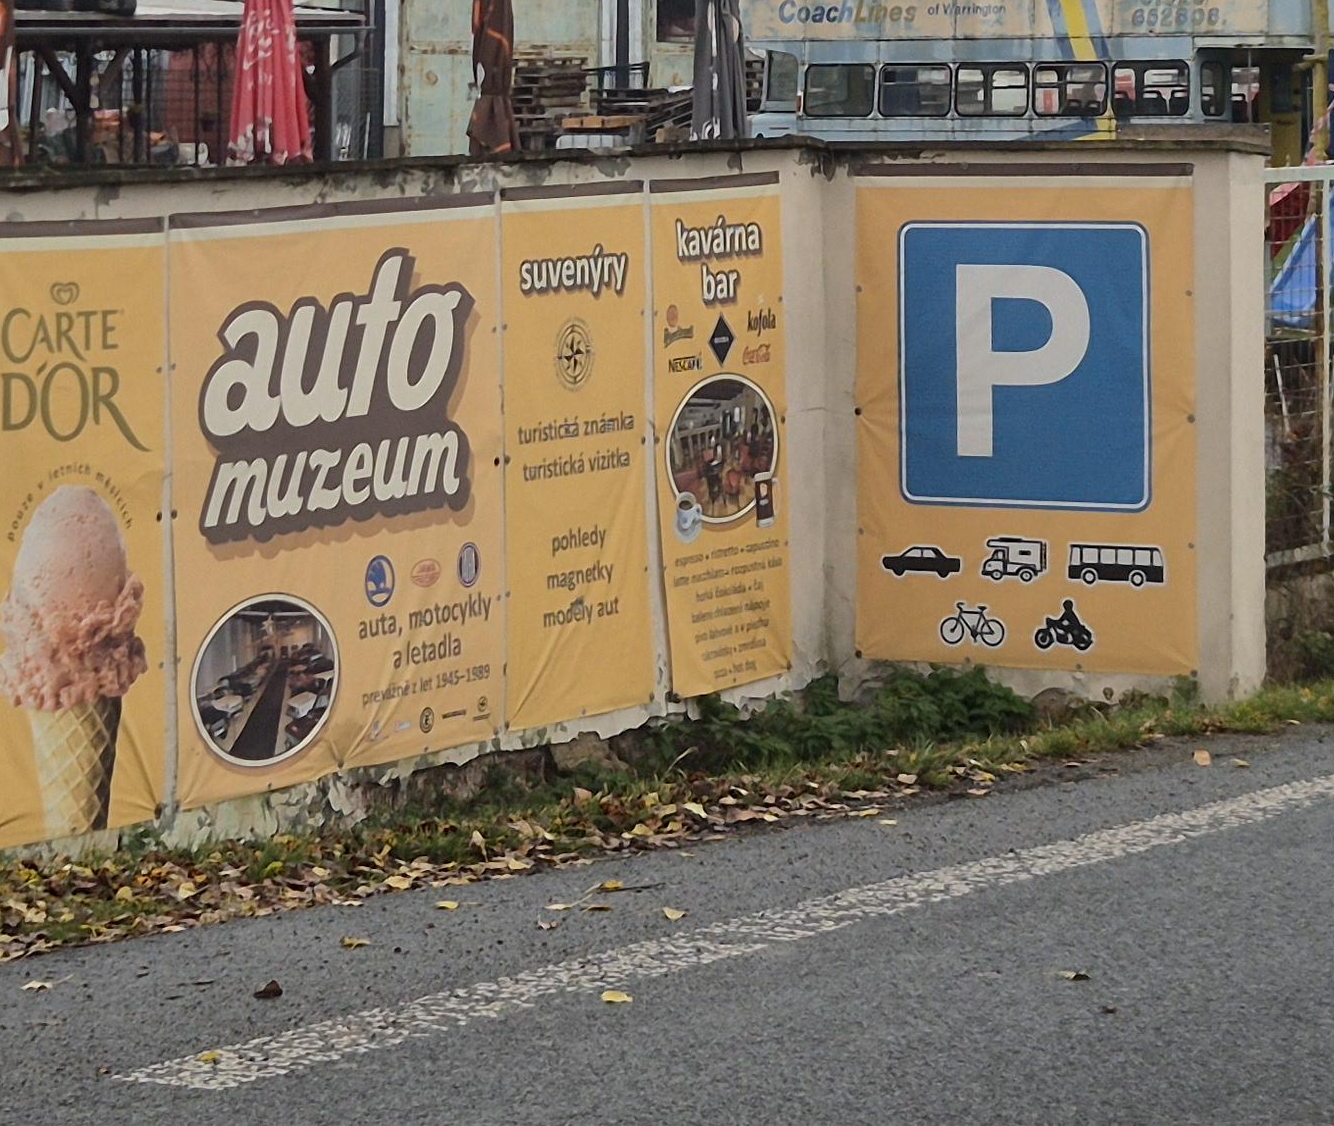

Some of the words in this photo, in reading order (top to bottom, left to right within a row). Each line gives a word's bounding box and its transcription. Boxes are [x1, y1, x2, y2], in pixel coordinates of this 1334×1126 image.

[927, 2, 939, 16] of
[942, 0, 1007, 19] Warrington
[675, 216, 763, 260] kavárna
[520, 243, 628, 295] suvenýry
[701, 264, 739, 302] bar
[0, 306, 120, 364] CARTE
[747, 308, 777, 337] kofola
[202, 252, 467, 440] auto
[956, 263, 1091, 457] P
[518, 415, 580, 445] turistická
[583, 410, 635, 437] známka
[202, 429, 464, 529] muzeum
[522, 454, 585, 482] turistická
[589, 447, 631, 472] vizitka
[551, 524, 607, 557] pohledy
[546, 560, 614, 592] magnetky
[358, 613, 403, 640] auta,
[408, 591, 492, 630] motocykly
[543, 599, 594, 629] modely
[597, 596, 620, 618] aut
[392, 650, 403, 670] a
[406, 632, 463, 666] letadla
[420, 677, 433, 693] let
